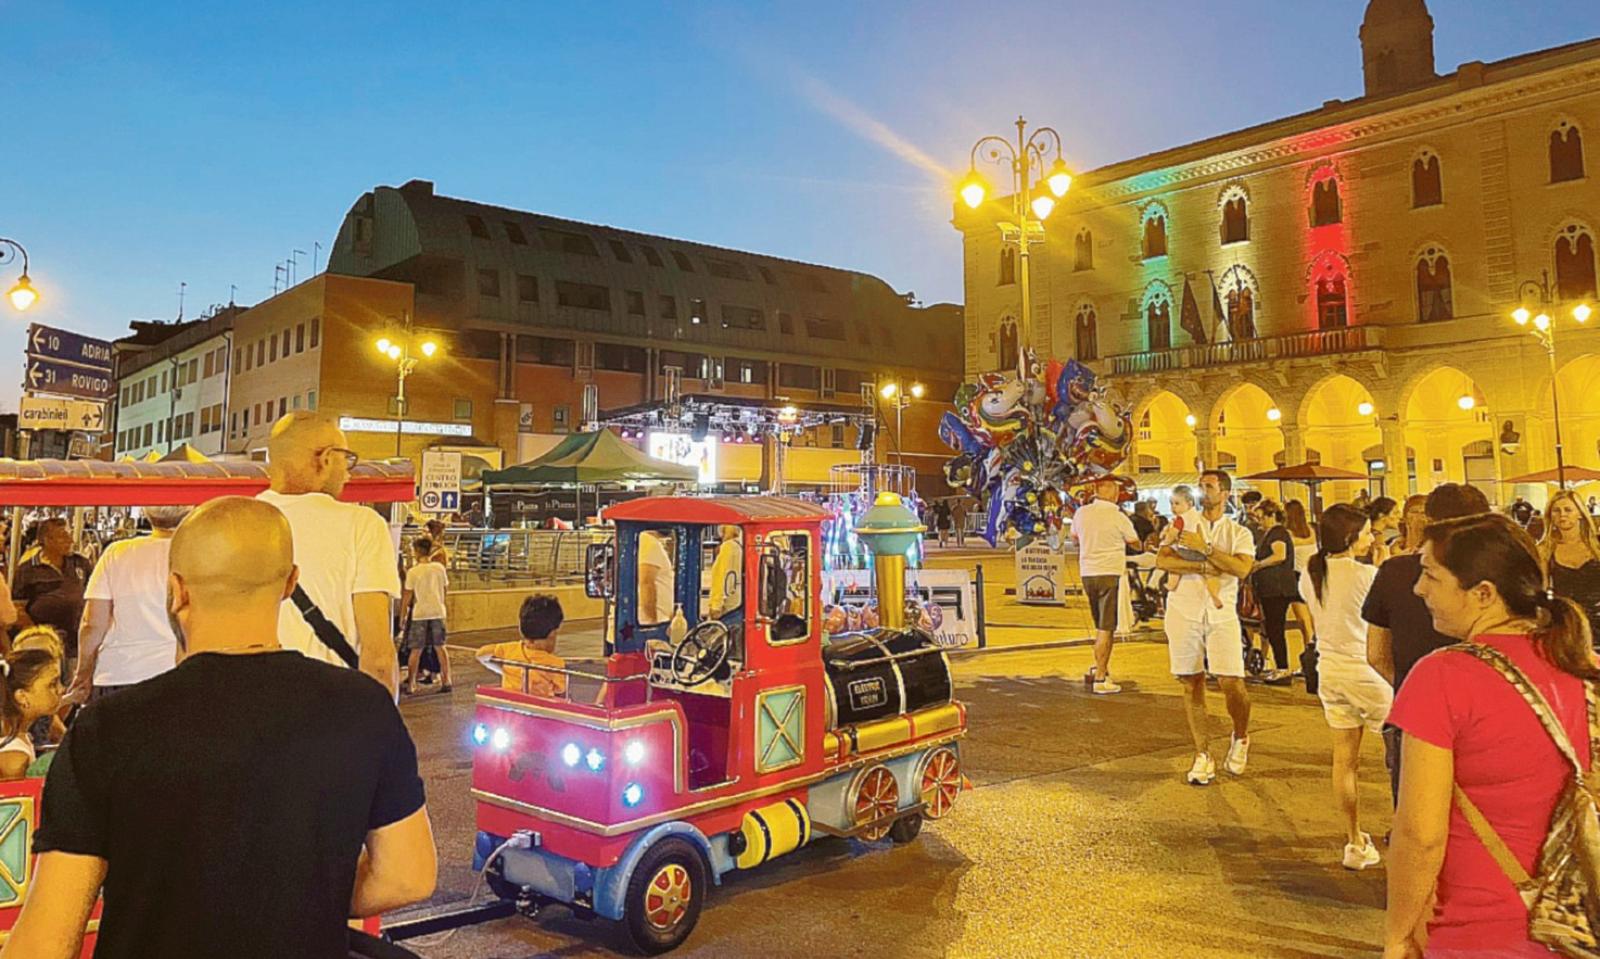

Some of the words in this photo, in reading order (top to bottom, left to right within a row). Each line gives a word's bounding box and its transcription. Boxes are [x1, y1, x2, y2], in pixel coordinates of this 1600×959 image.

[48, 335, 60, 351] 10
[81, 343, 111, 361] ADRIA
[45, 369, 56, 384] 31
[71, 374, 109, 392] ROVIGO
[23, 407, 69, 421] carabinieri
